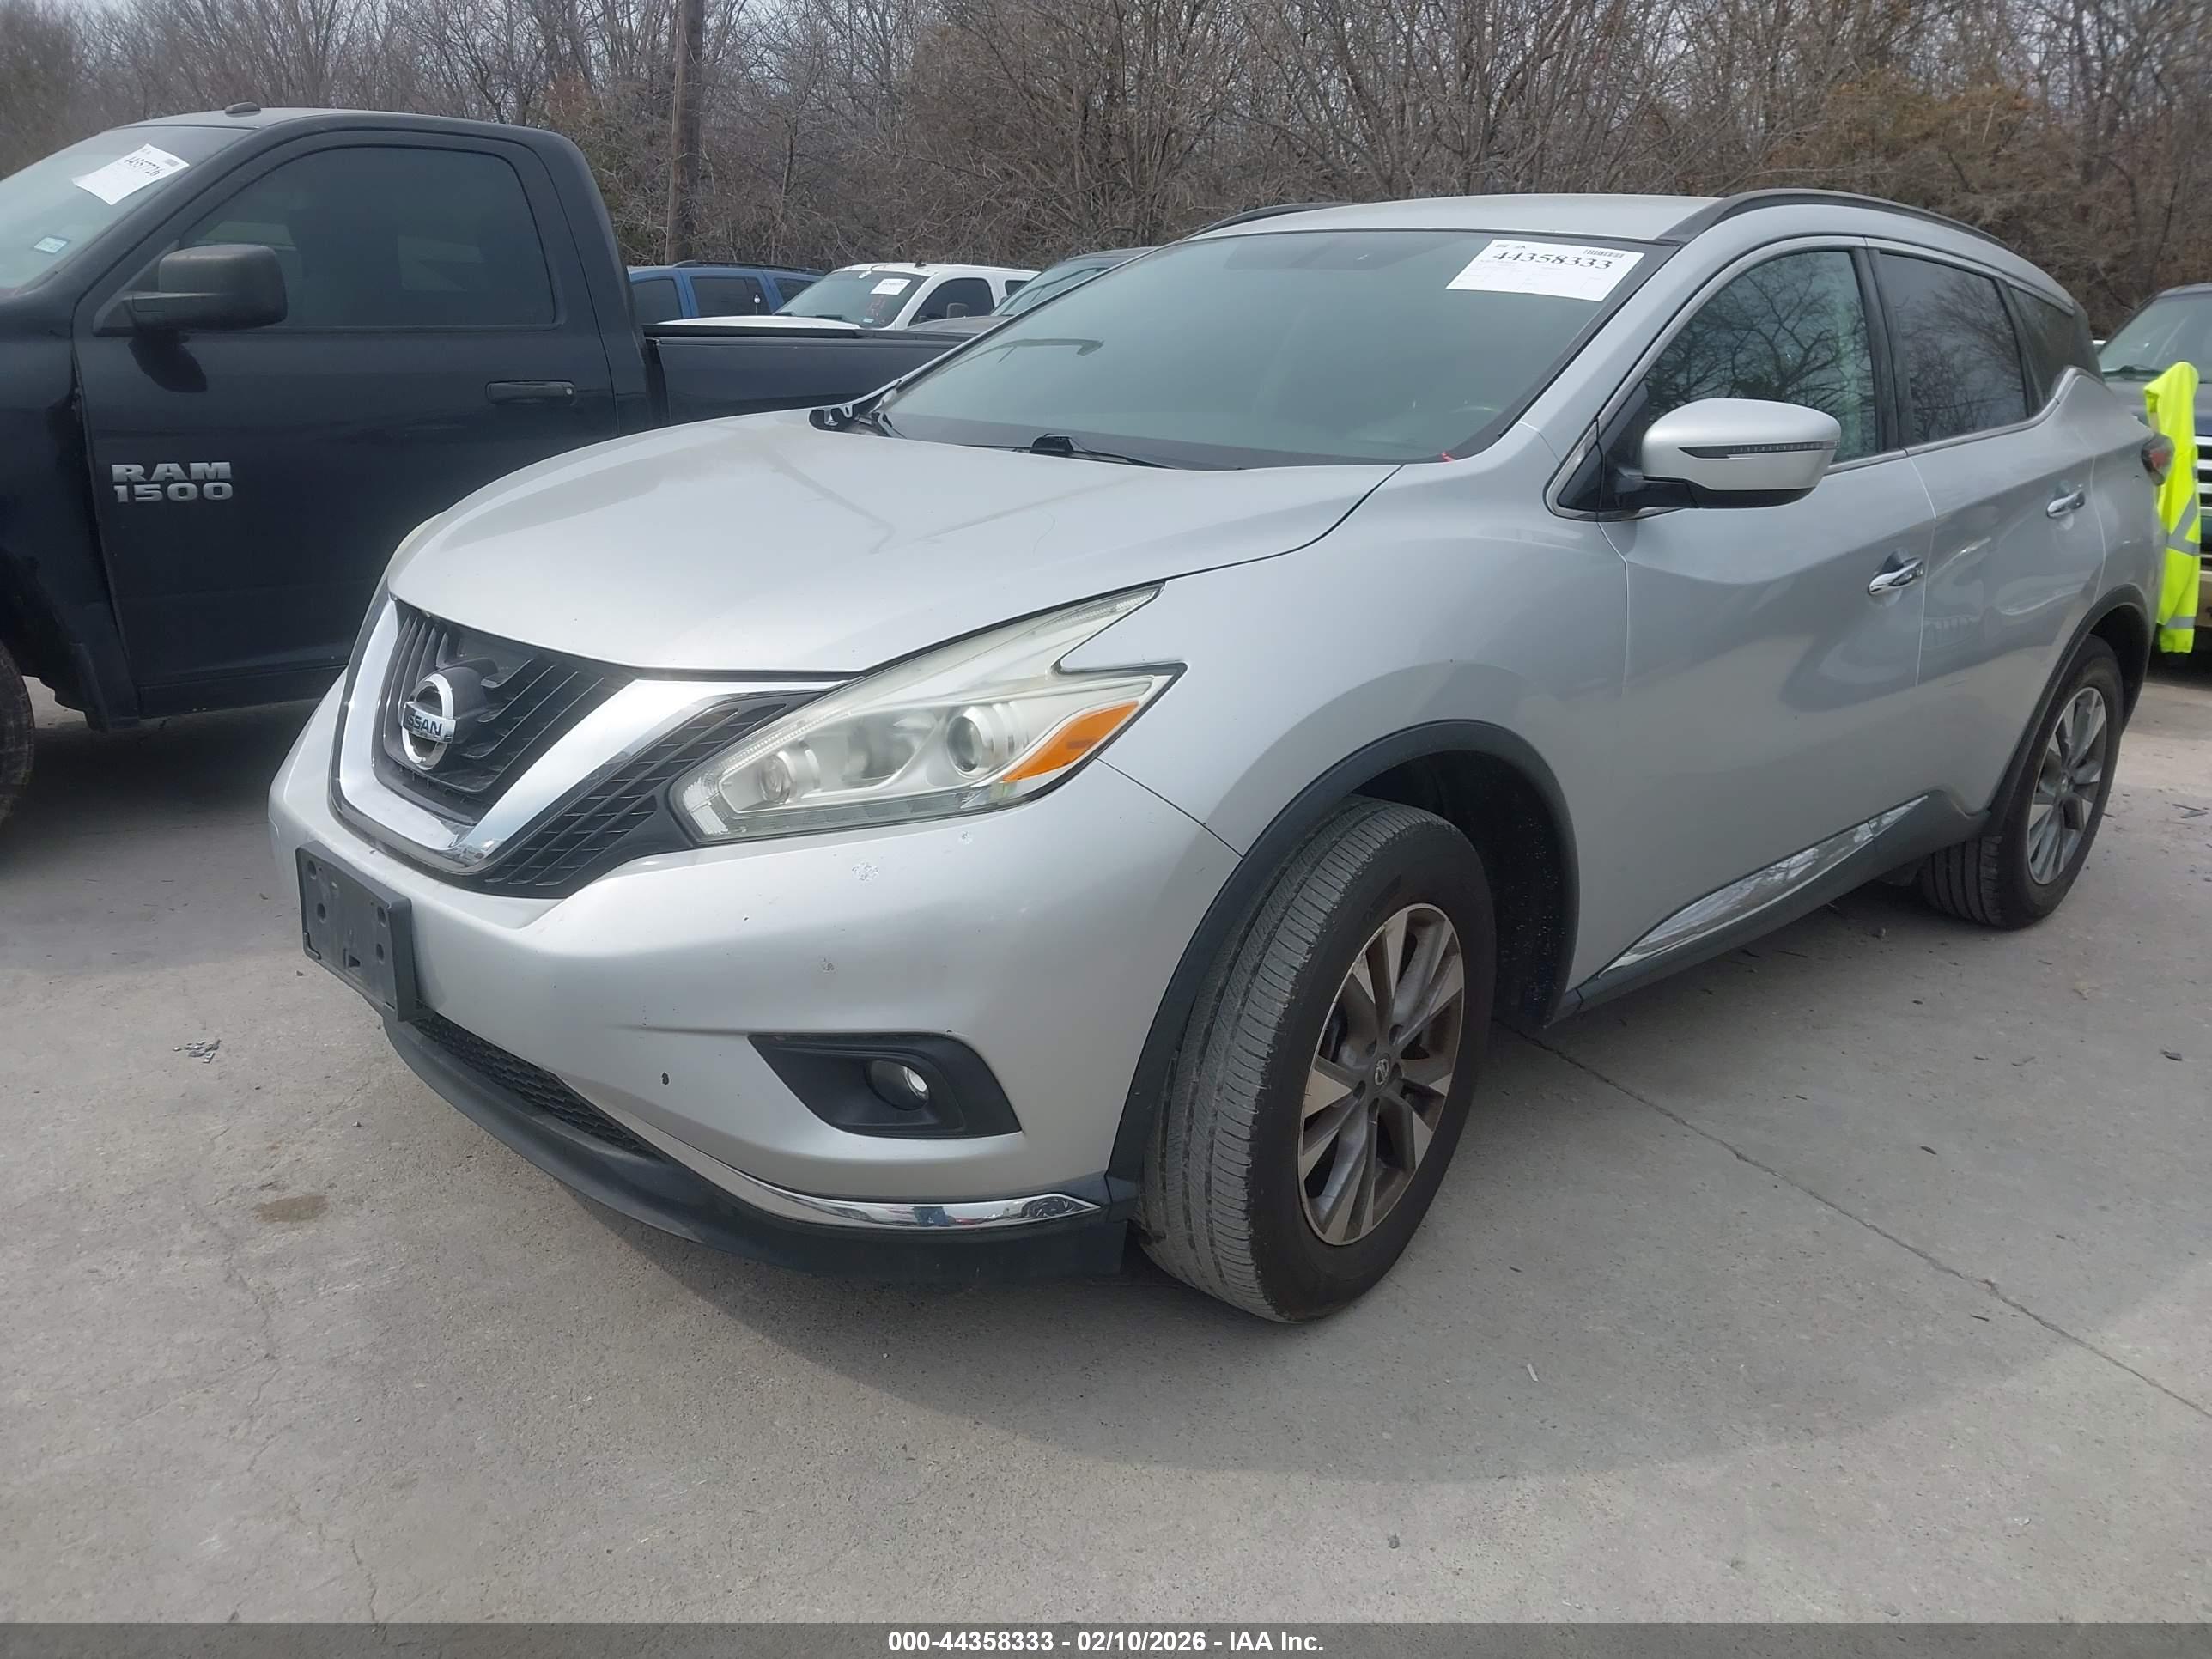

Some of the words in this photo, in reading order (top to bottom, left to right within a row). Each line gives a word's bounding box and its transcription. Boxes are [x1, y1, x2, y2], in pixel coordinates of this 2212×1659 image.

[1493, 251, 1613, 270] 44358333
[111, 461, 232, 482] RAM
[113, 482, 234, 503] 1500
[404, 713, 442, 736] SSAN
